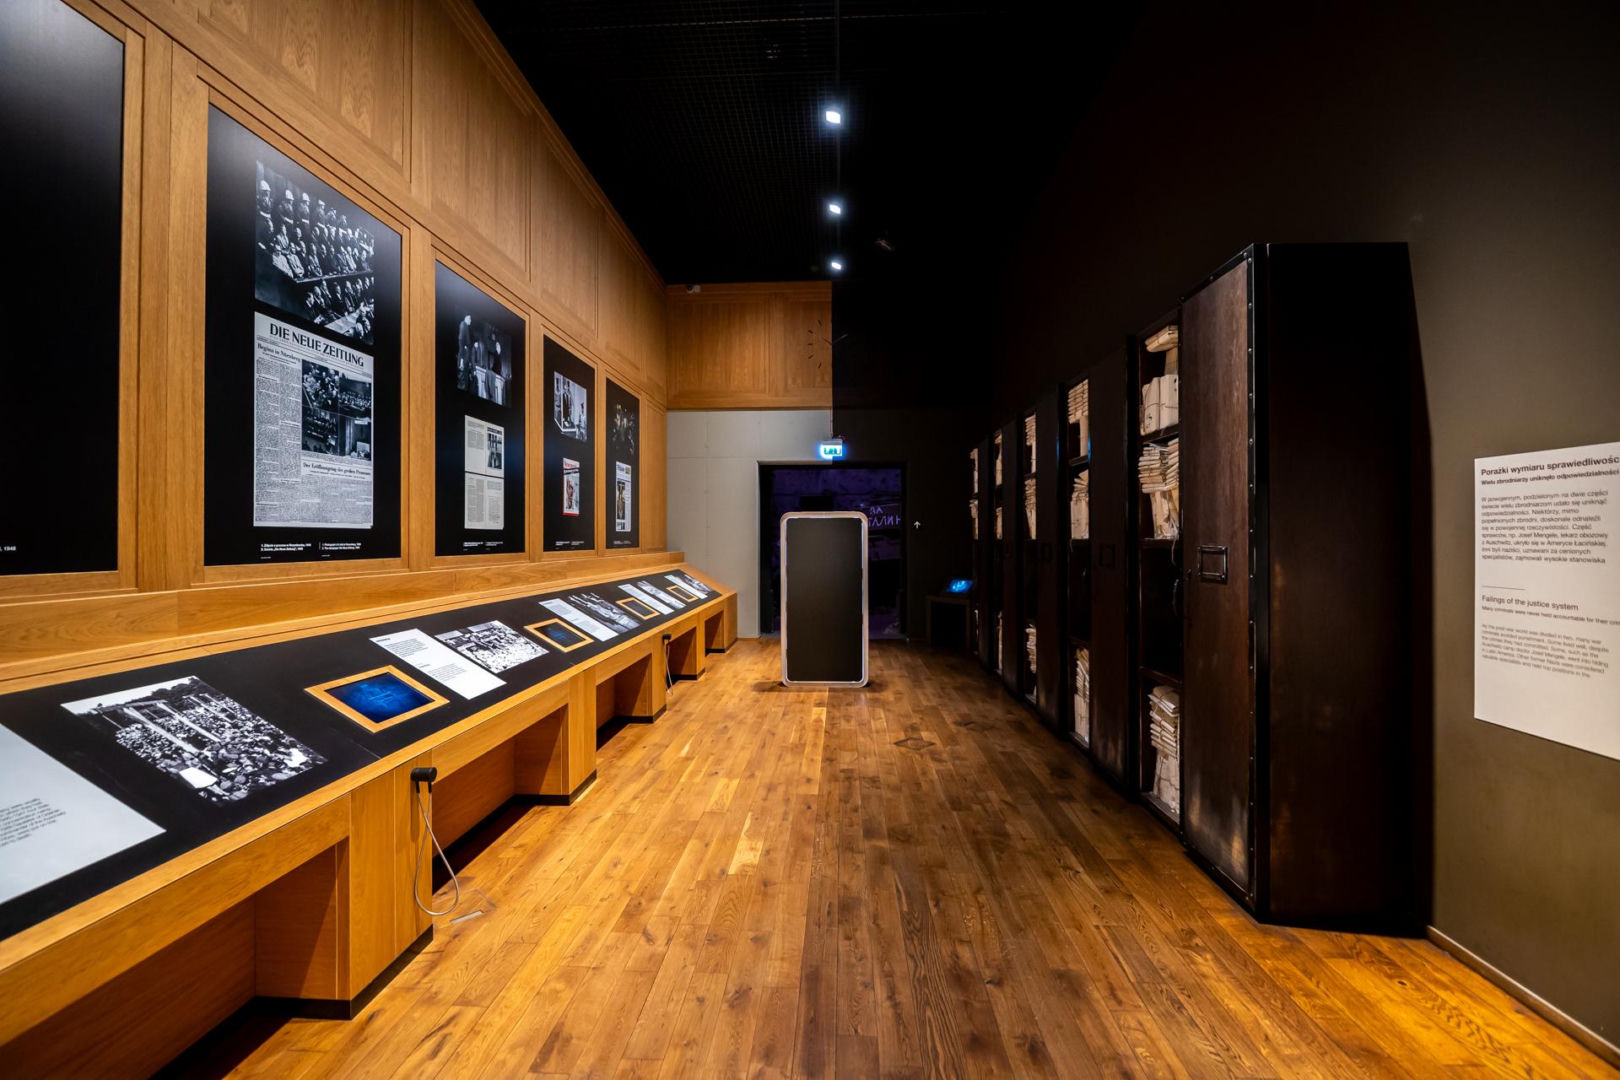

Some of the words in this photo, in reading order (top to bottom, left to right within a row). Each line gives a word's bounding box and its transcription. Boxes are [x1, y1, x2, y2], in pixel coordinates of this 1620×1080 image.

[270, 322, 290, 340] DIE
[292, 332, 322, 352] NEUE
[323, 342, 364, 367] ZEITUNG
[1481, 466, 1508, 476] Porażki
[1510, 464, 1545, 474] wymiaru
[1546, 455, 1620, 470] sprawiedliwośc
[1527, 600, 1550, 608] justice
[1551, 603, 1578, 611] system
